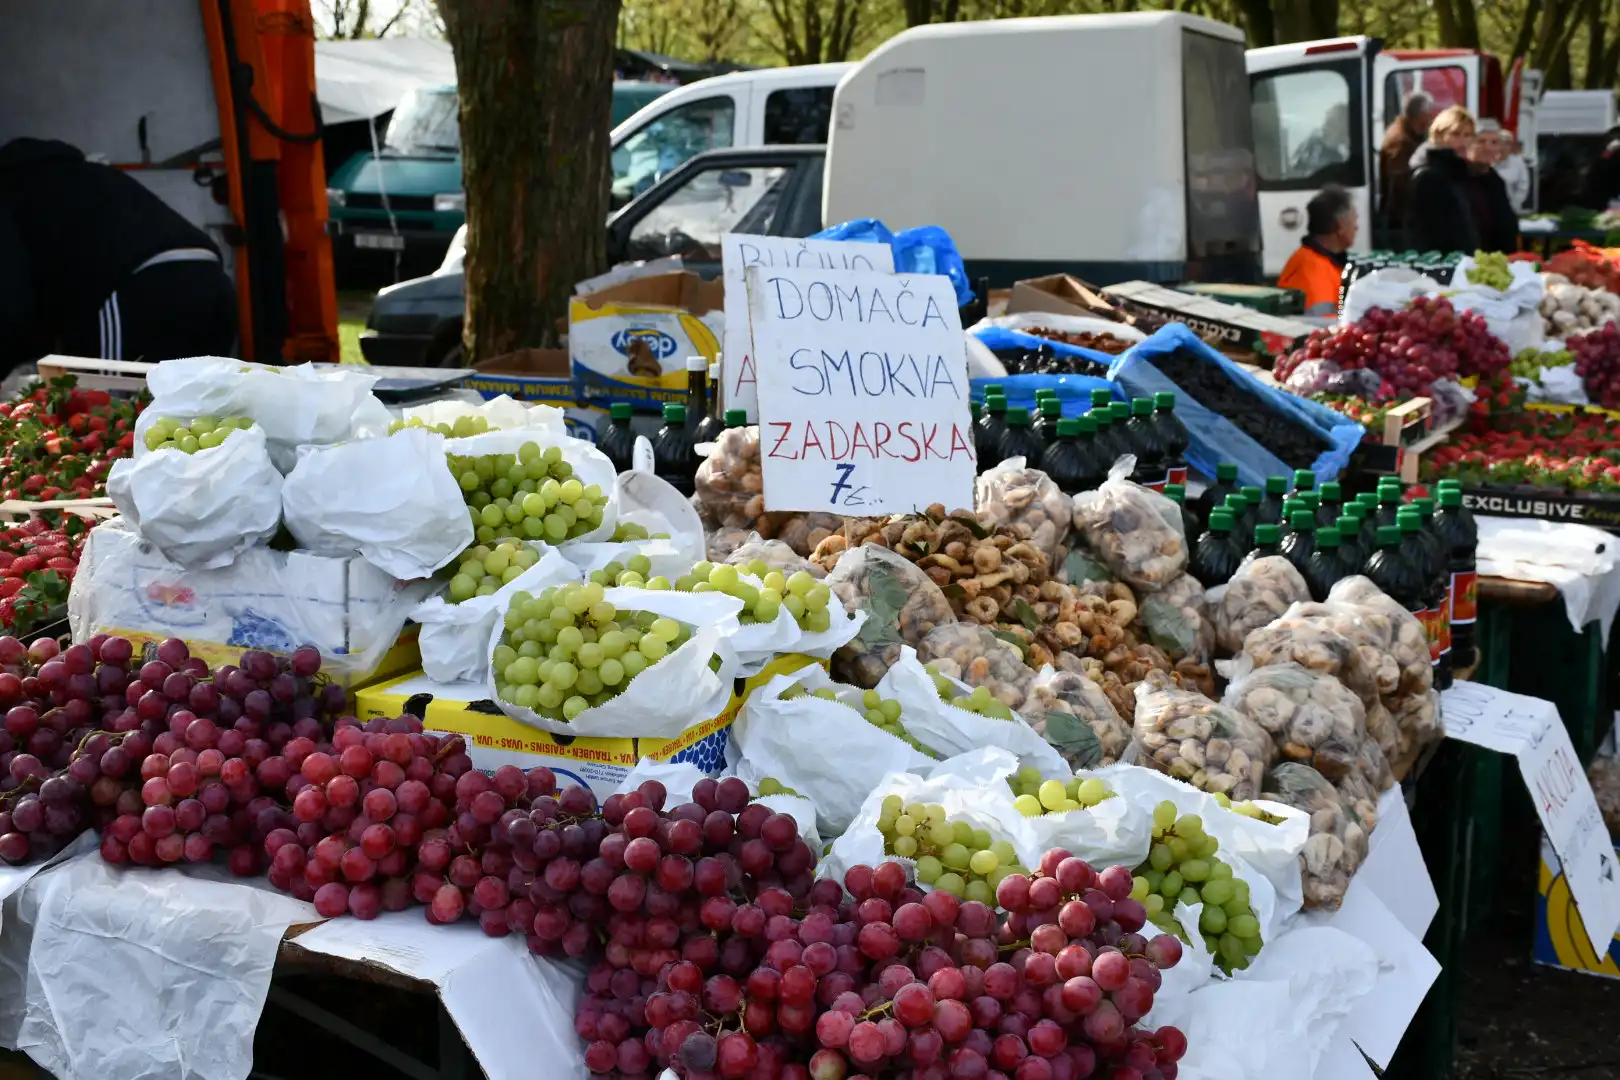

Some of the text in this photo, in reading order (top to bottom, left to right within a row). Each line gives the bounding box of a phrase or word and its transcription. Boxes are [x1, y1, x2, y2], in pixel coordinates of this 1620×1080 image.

[767, 277, 949, 330] DOMAČA
[790, 348, 960, 399] SMOKVA
[768, 420, 975, 462] ZADARSKA
[1462, 494, 1584, 518] EXCLUSIVE
[476, 733, 493, 746] UVA
[501, 737, 523, 750] UVAS
[530, 741, 565, 756] RAISINS
[572, 746, 612, 762] TRAUBEN
